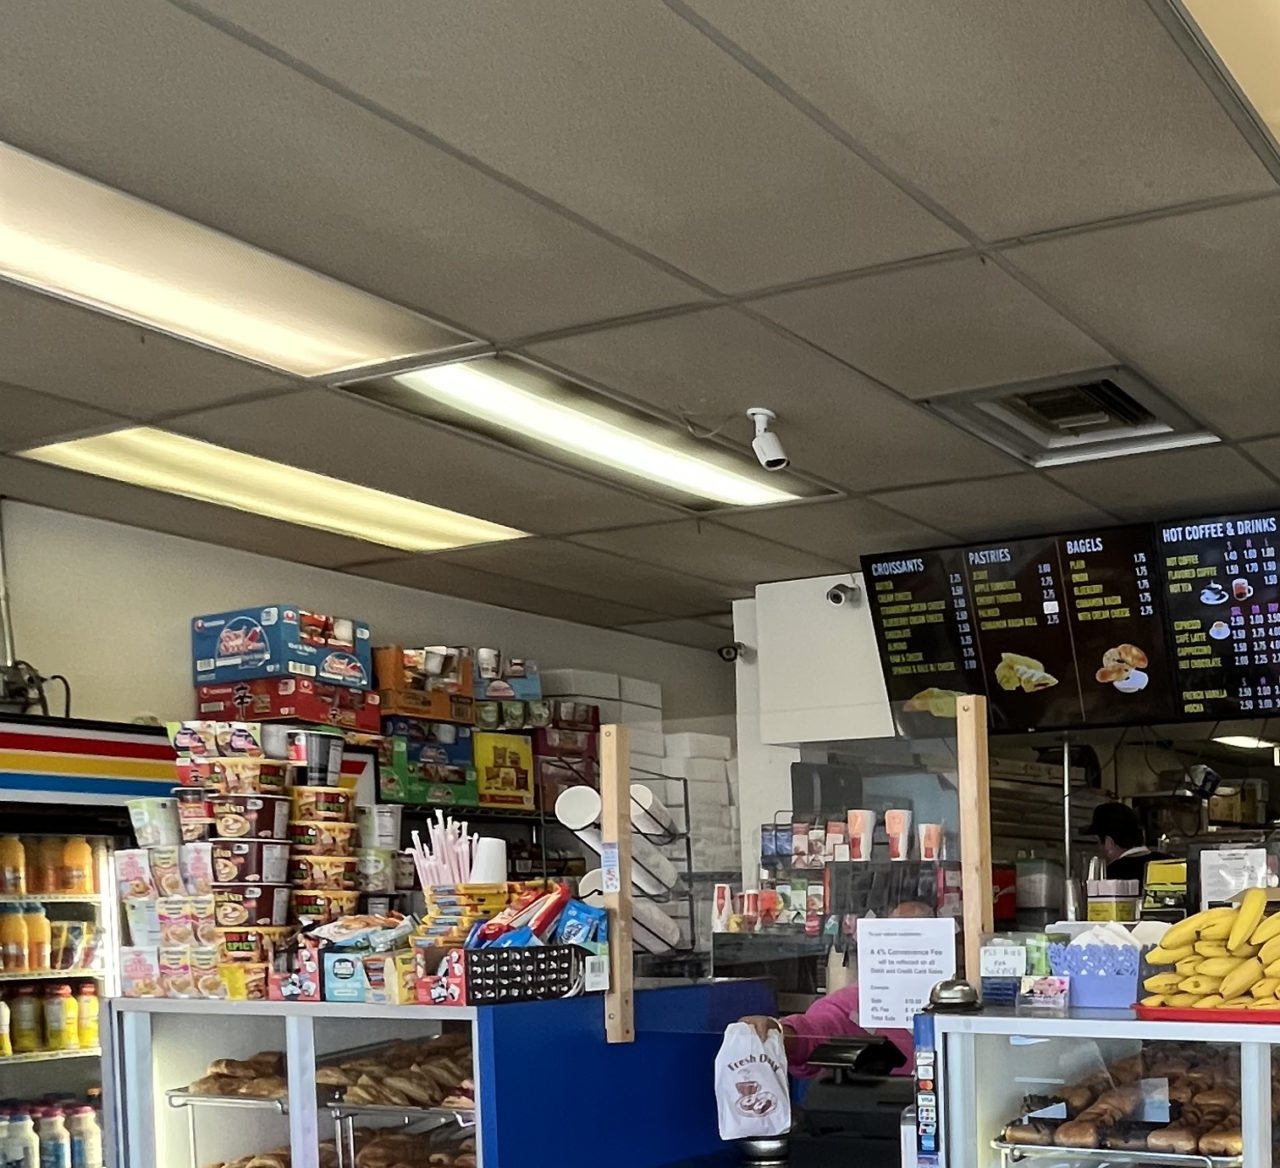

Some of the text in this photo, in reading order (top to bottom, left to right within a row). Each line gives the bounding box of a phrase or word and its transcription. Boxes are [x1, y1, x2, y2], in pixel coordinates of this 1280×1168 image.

[1163, 518, 1276, 542] HOT COFFEE & DRINKS
[1067, 538, 1103, 554] BAGELS
[969, 549, 1010, 565] PASTRIES
[872, 559, 924, 576] CROISSANTS
[226, 942, 255, 951] SPICY
[728, 1054, 756, 1071] Fresh
